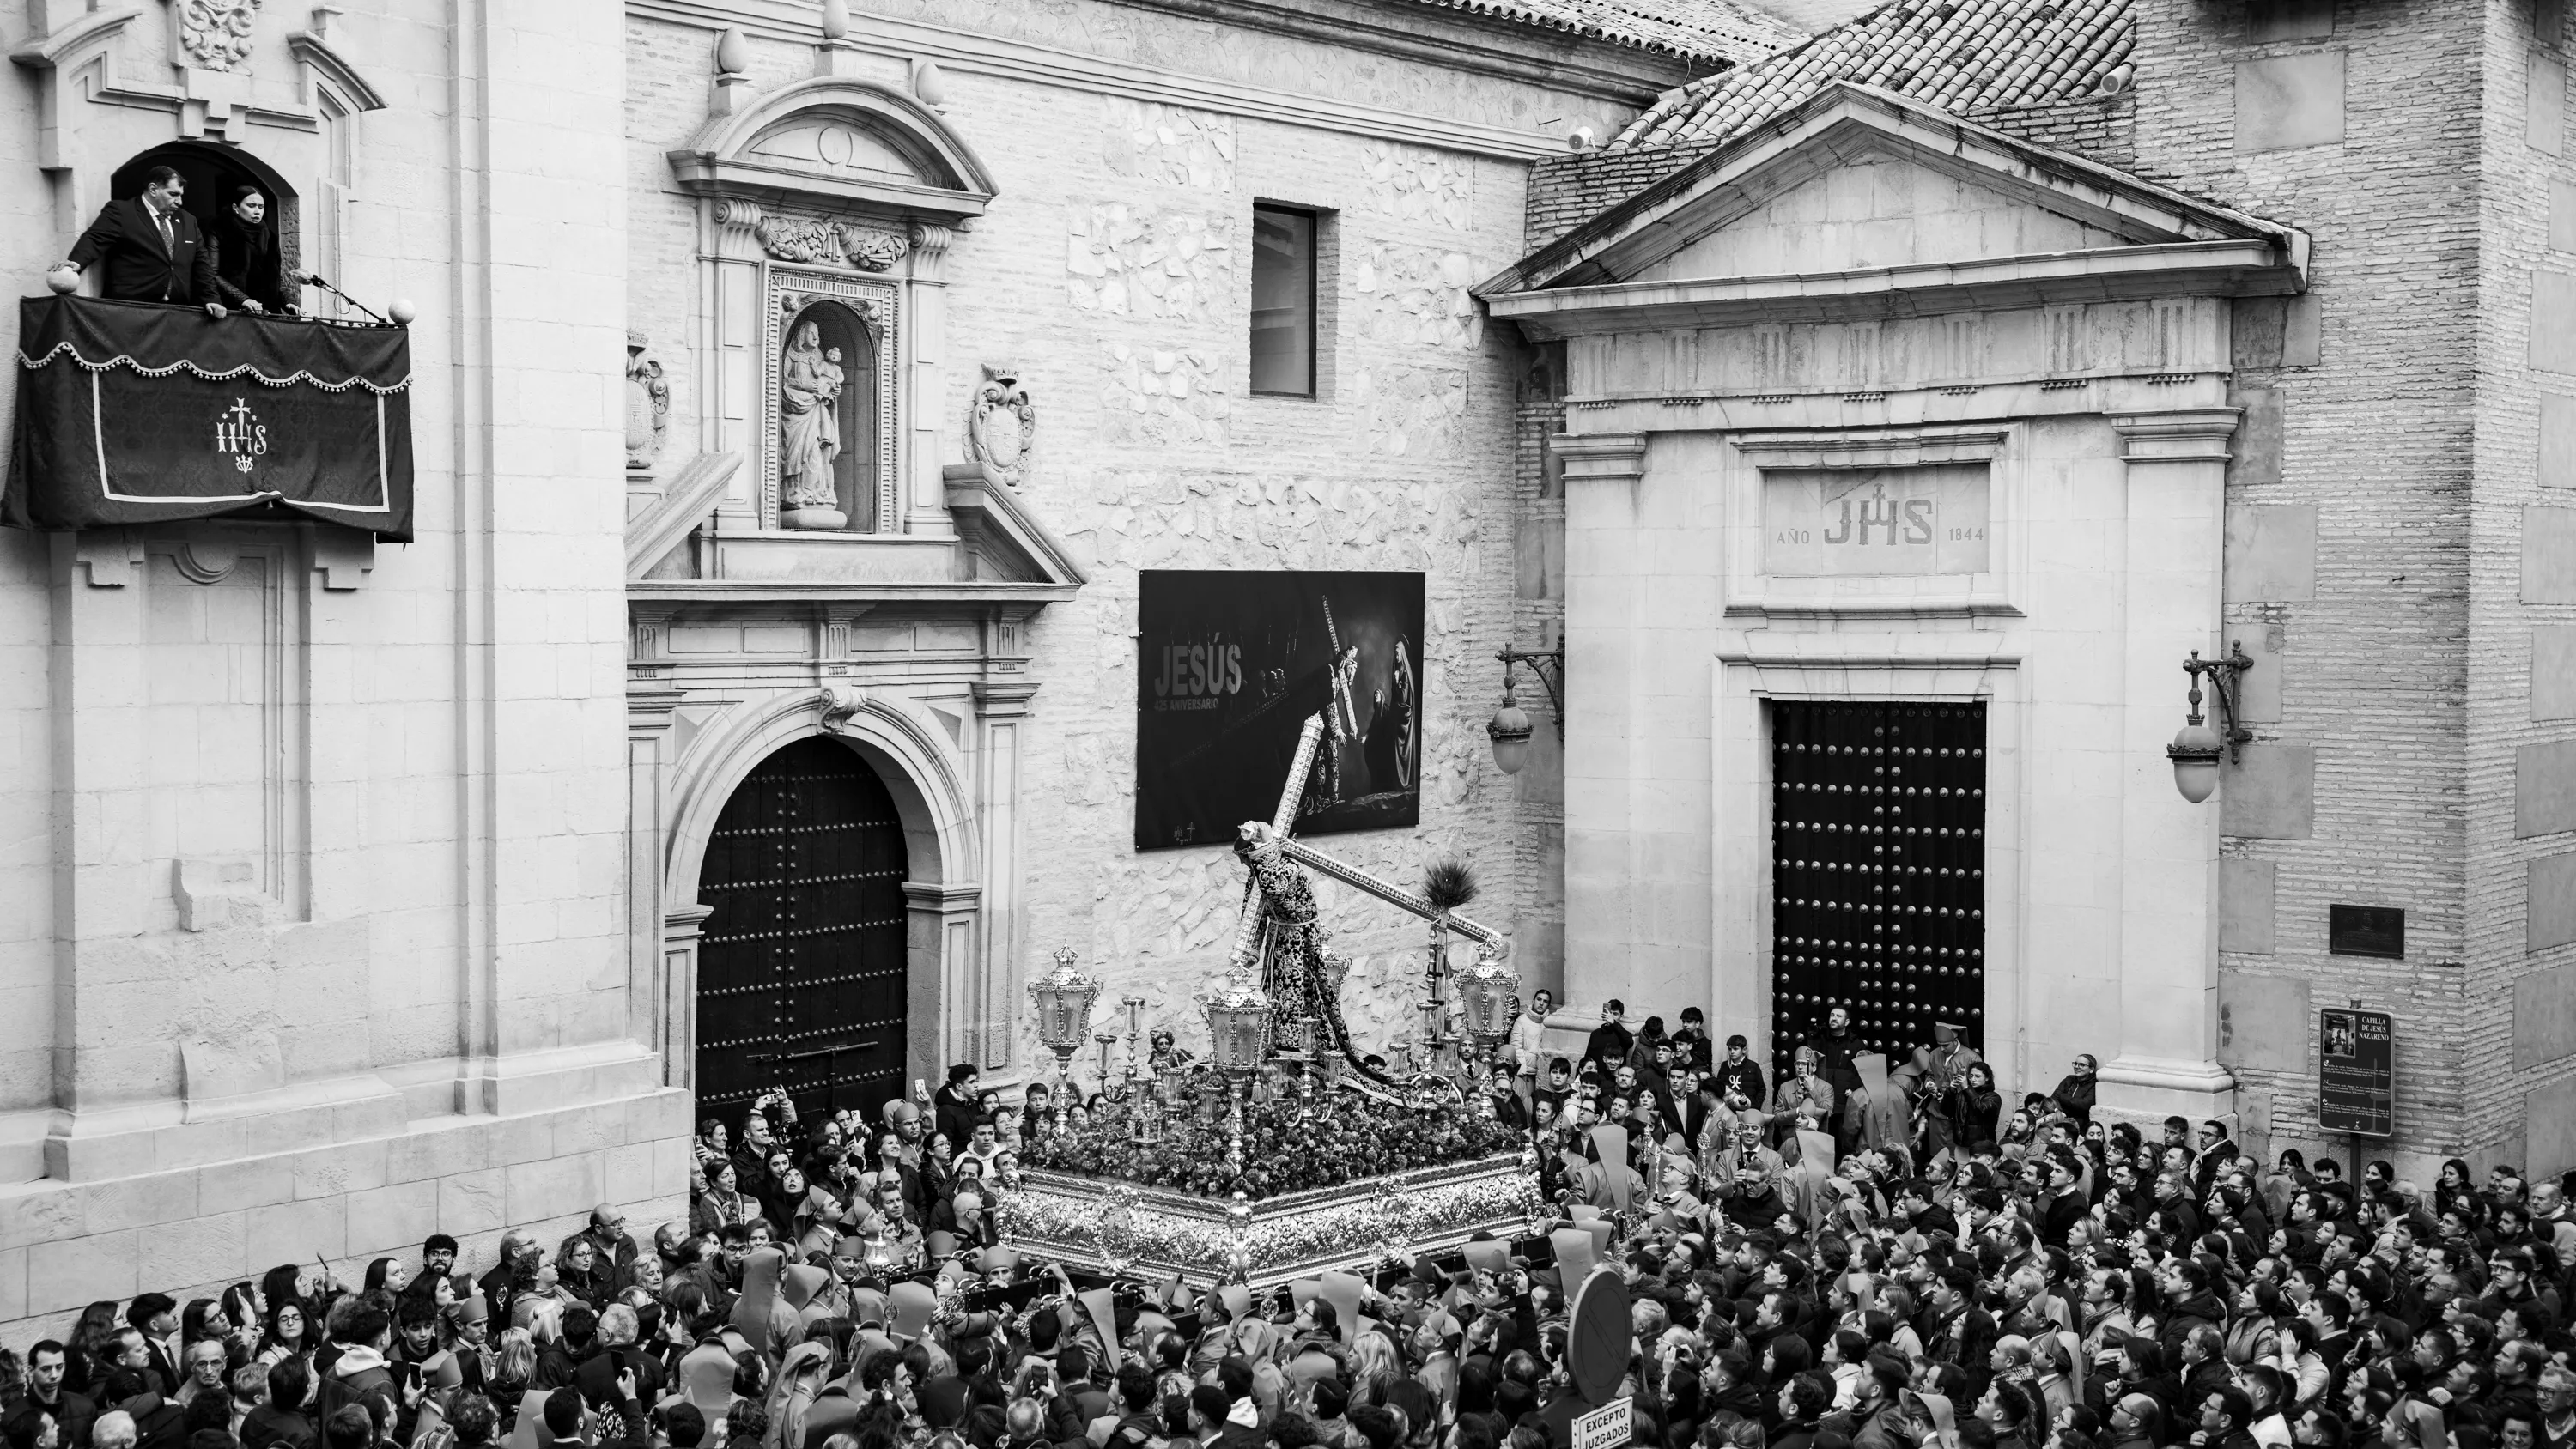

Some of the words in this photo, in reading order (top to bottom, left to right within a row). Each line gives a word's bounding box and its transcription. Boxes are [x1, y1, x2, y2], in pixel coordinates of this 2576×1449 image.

[1777, 528, 1810, 544] AÑO
[1824, 494, 1933, 545] JHS
[1949, 527, 1984, 541] 1844
[1154, 632, 1242, 697] JESÚS
[1154, 700, 1168, 712] 425
[1169, 698, 1218, 711] ANIVERSARIO
[2361, 1016, 2386, 1026] CAPILLA
[2370, 1024, 2386, 1034] JESÚS
[2359, 1032, 2390, 1041] NAZARENO
[1586, 1408, 1625, 1433] EXCEPTO
[1584, 1423, 1629, 1449] JUZGADOS
